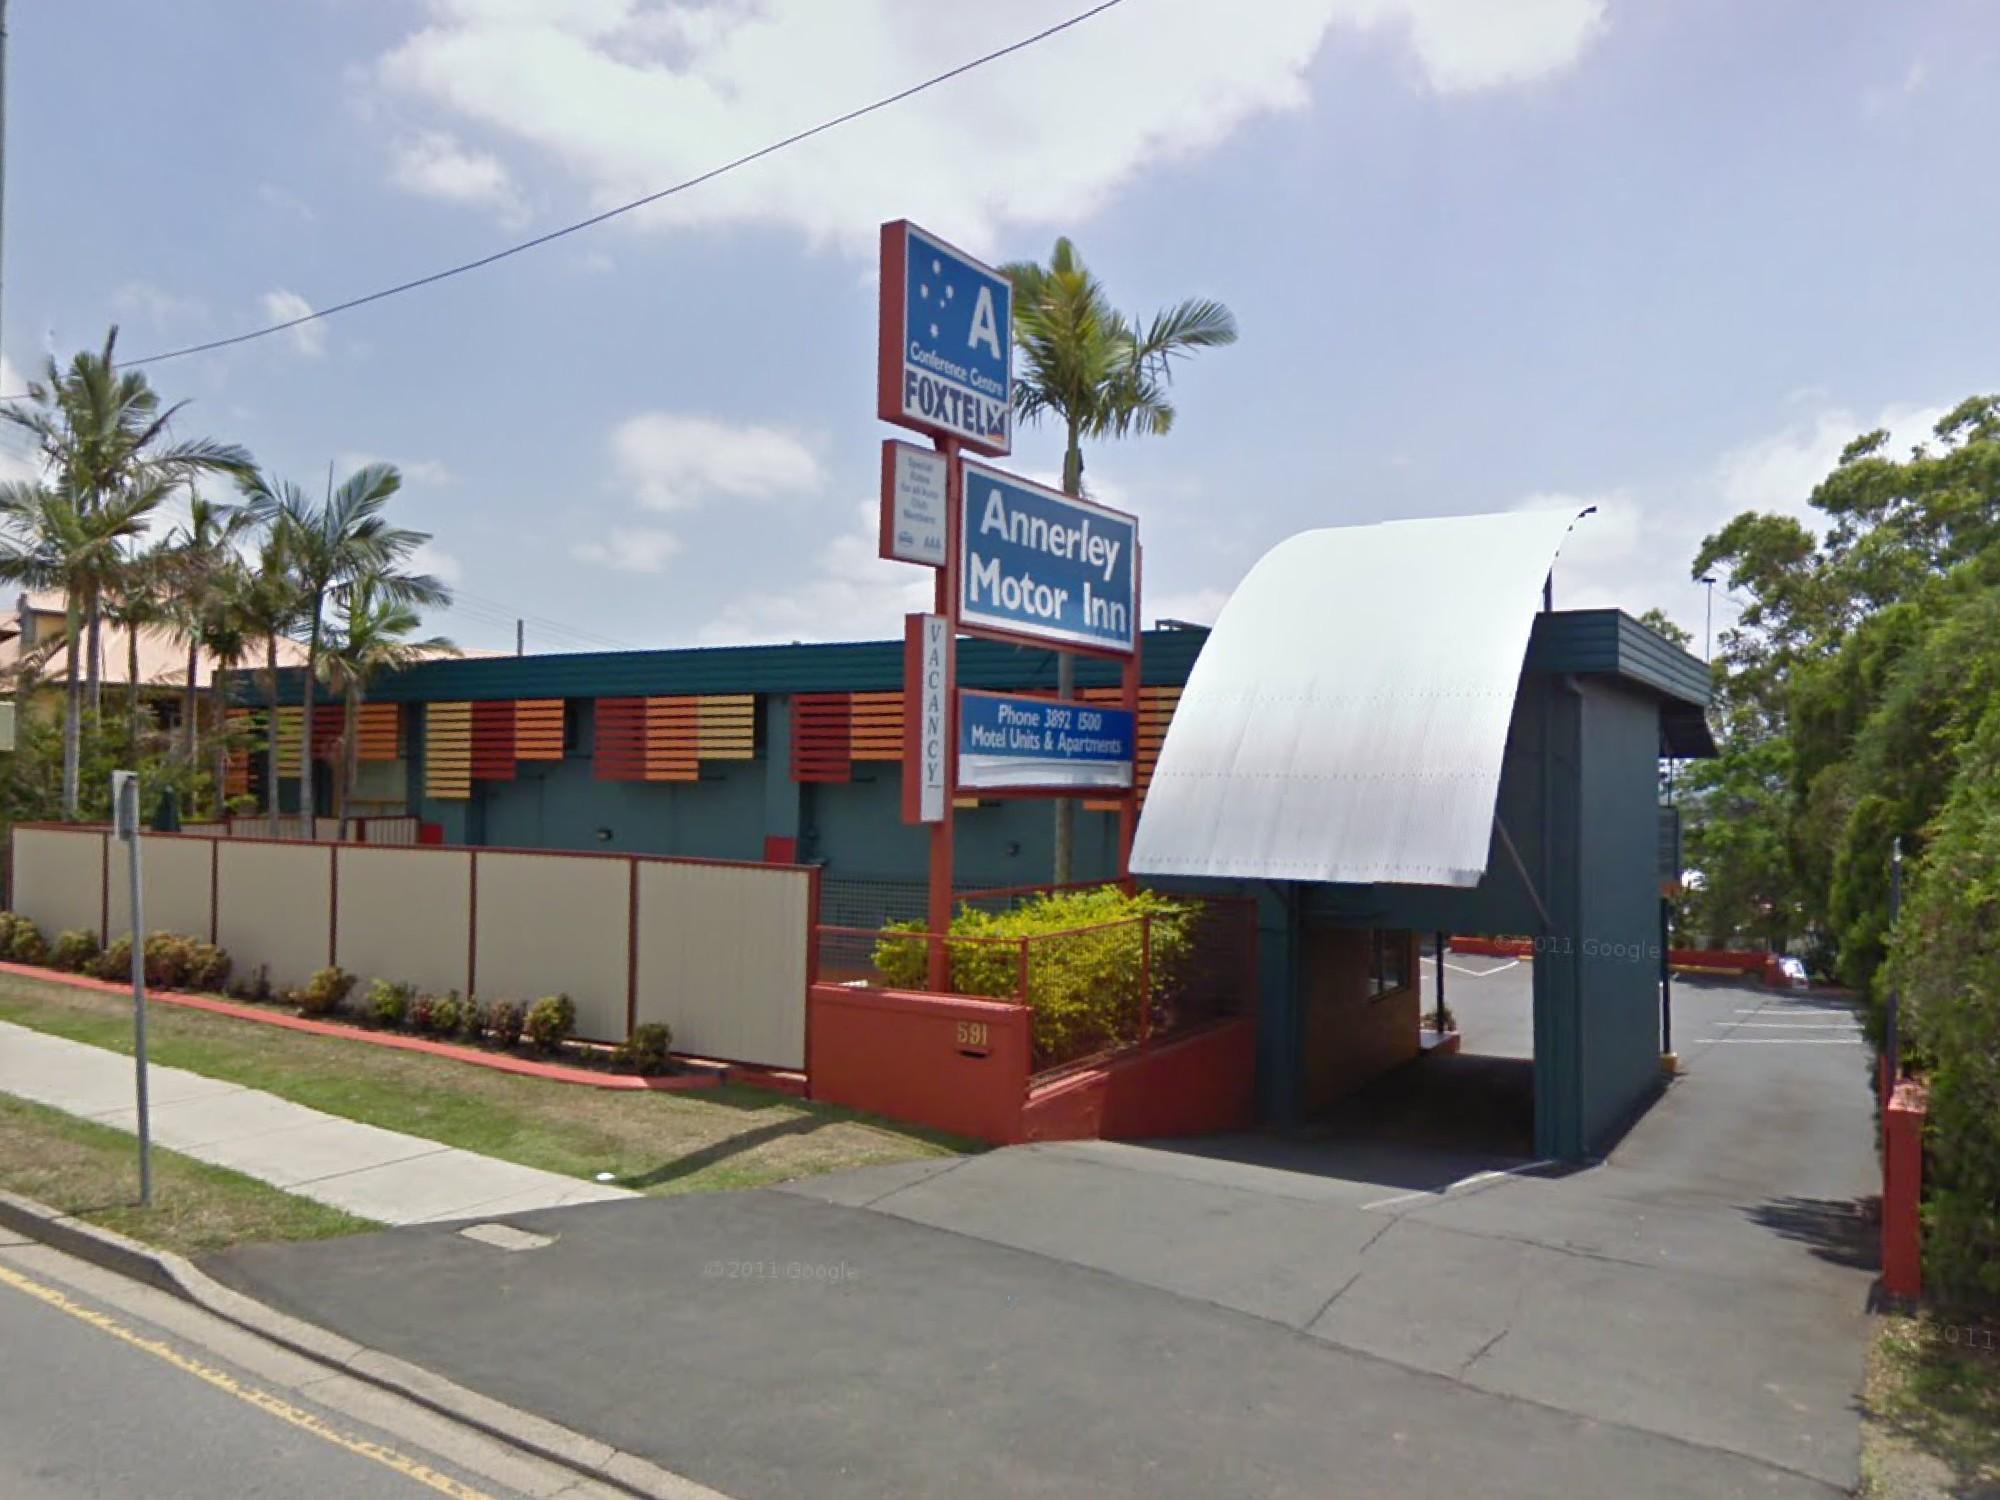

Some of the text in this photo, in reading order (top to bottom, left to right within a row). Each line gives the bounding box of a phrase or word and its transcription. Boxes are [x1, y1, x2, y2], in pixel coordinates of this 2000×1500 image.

[968, 286, 1001, 361] A
[911, 341, 1004, 396] Conference Centre
[905, 371, 985, 436] FOXTEL
[980, 488, 1120, 581] Annerley
[969, 551, 1126, 633] Motor Inn
[927, 624, 942, 782] VACANCY
[997, 703, 1102, 732] Phone 3892 1500
[971, 724, 1122, 759] Motel Units & Apartments
[957, 1020, 988, 1046] 591
